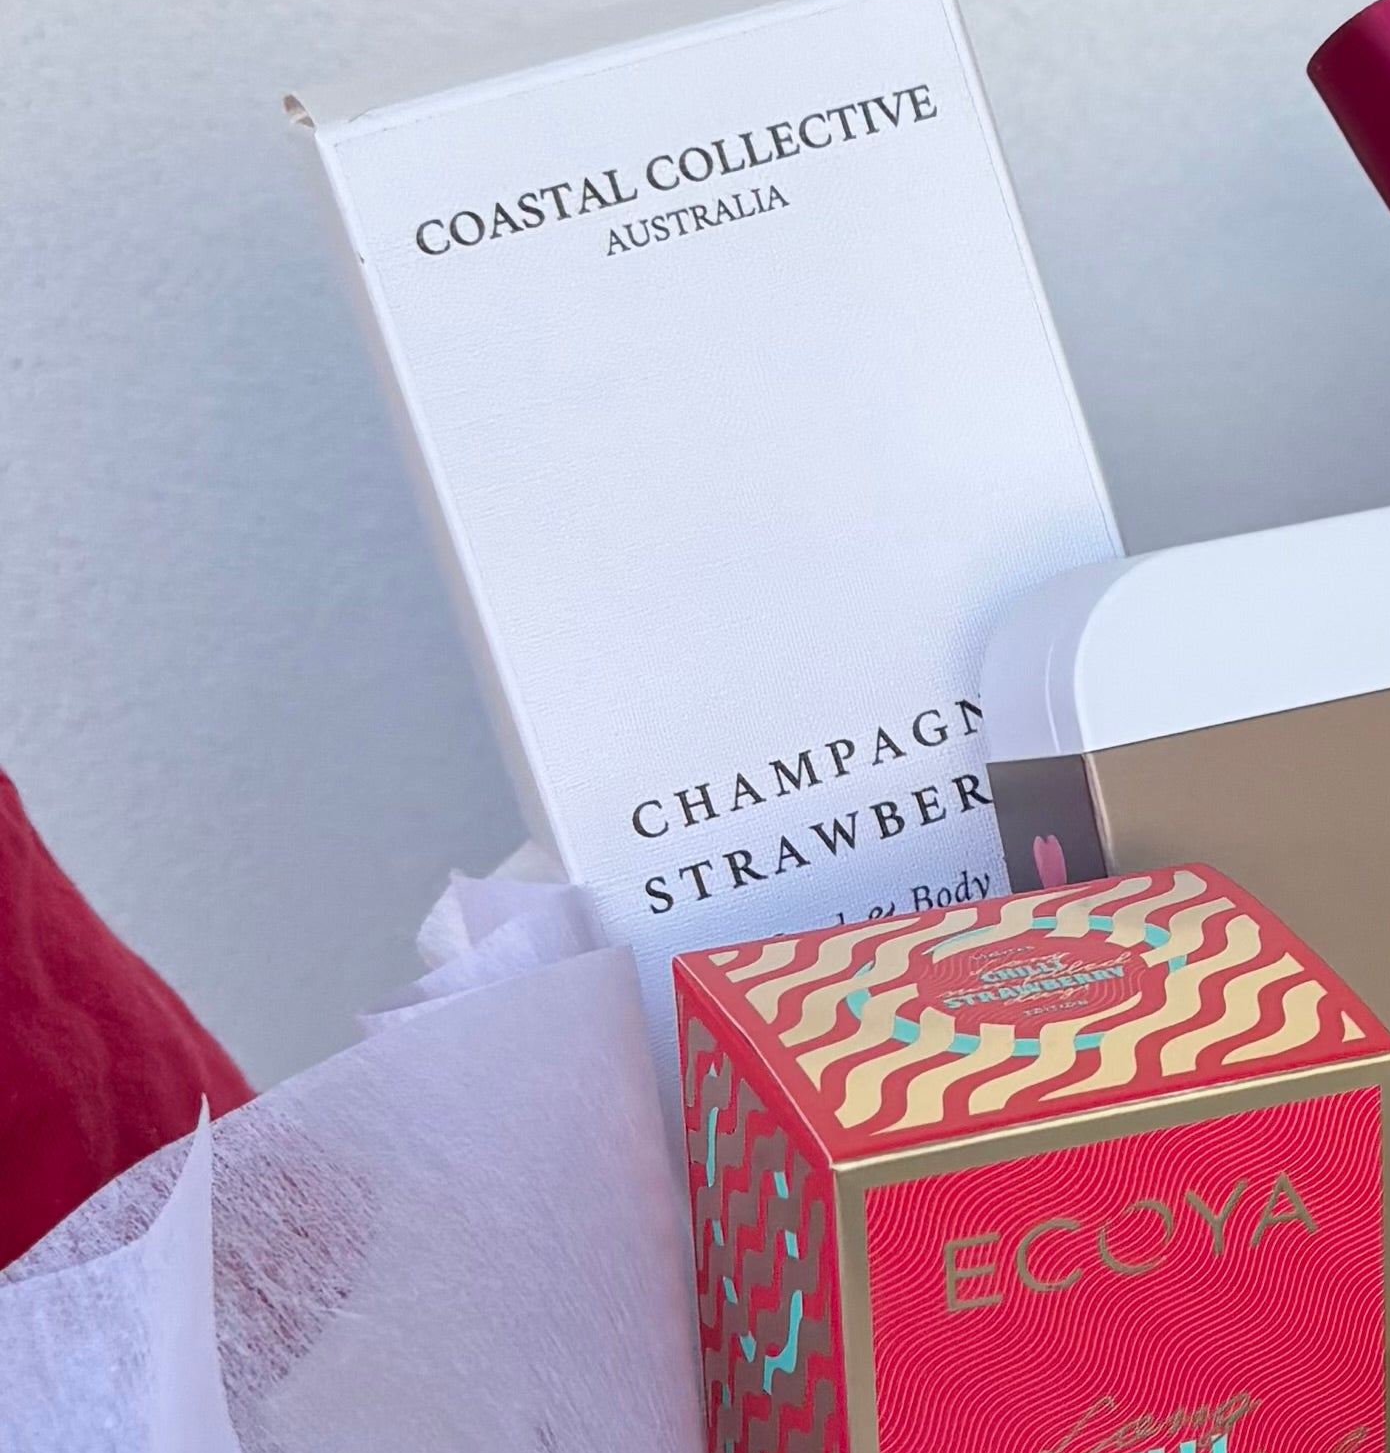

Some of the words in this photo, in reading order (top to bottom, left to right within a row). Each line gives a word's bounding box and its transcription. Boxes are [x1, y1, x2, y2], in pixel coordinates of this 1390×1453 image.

[415, 168, 638, 256] COASTAL
[645, 84, 938, 191] COLLECTIVE
[606, 184, 790, 256] AUSTRALIA
[631, 698, 984, 838] CHAMPAGN
[644, 773, 994, 915] STRAWBER
[911, 870, 990, 913] Body
[942, 1171, 1319, 1313] ECOYA
